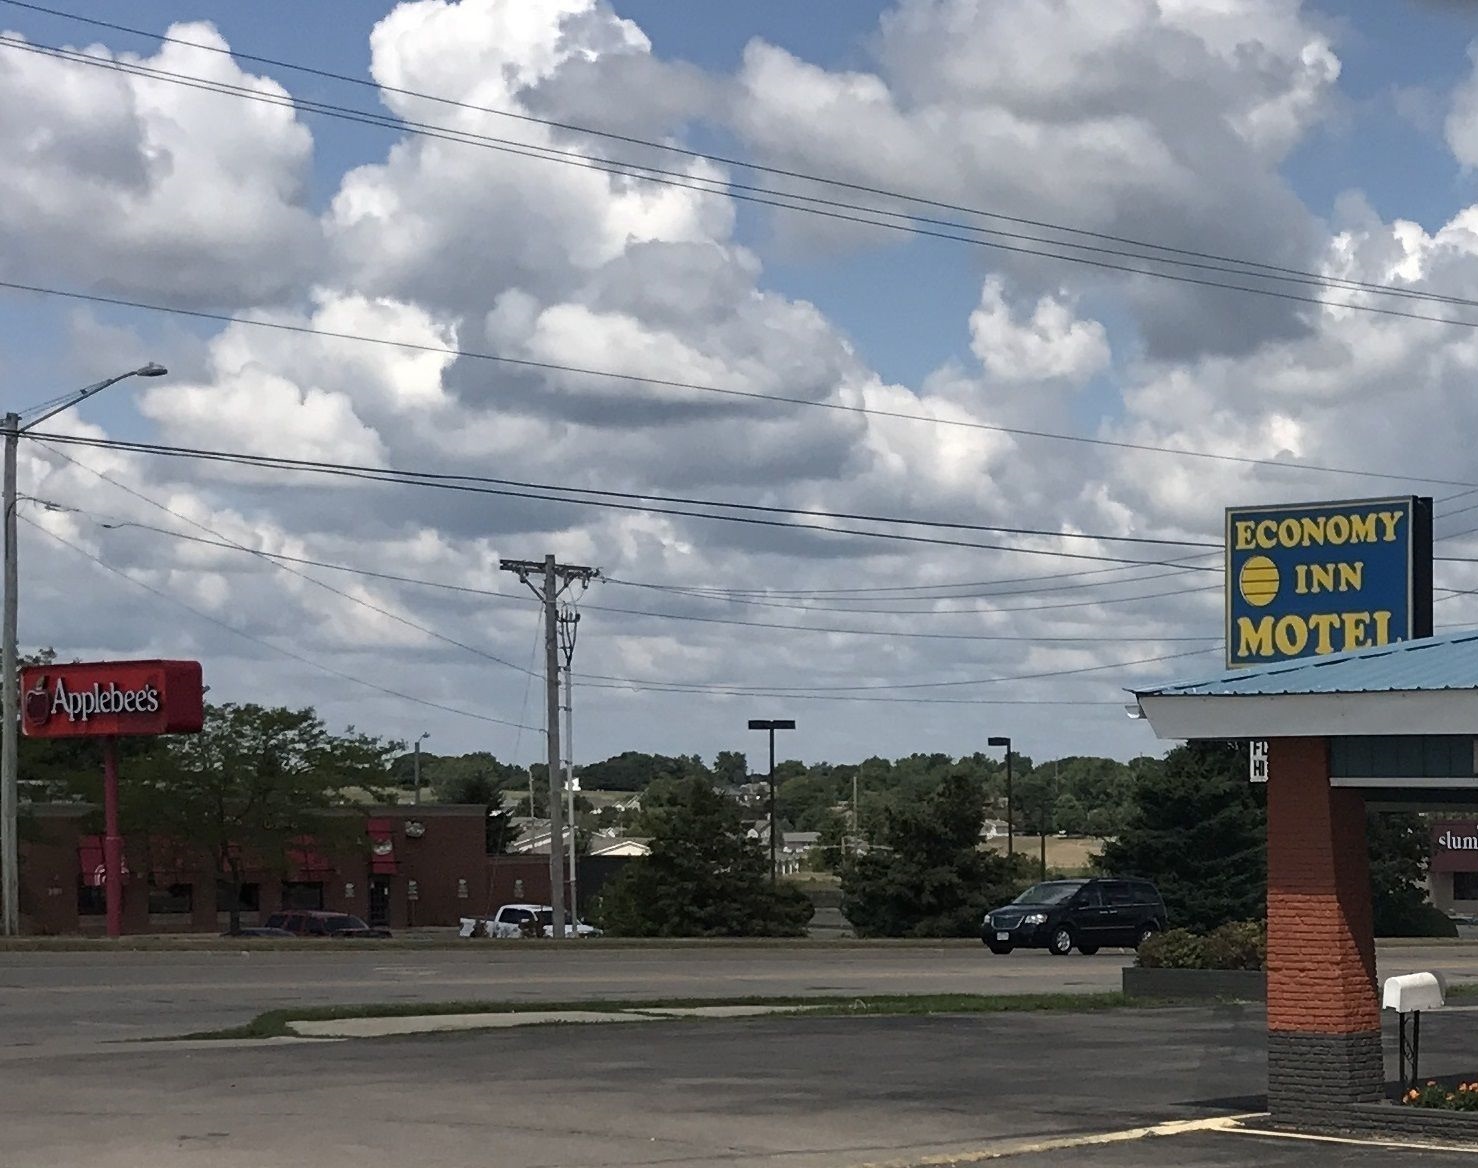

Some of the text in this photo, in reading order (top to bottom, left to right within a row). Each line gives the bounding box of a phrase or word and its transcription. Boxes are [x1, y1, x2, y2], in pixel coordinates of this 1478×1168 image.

[1235, 511, 1404, 550] ECONOMY
[1295, 562, 1364, 594] INN
[51, 677, 159, 722] Applebee's
